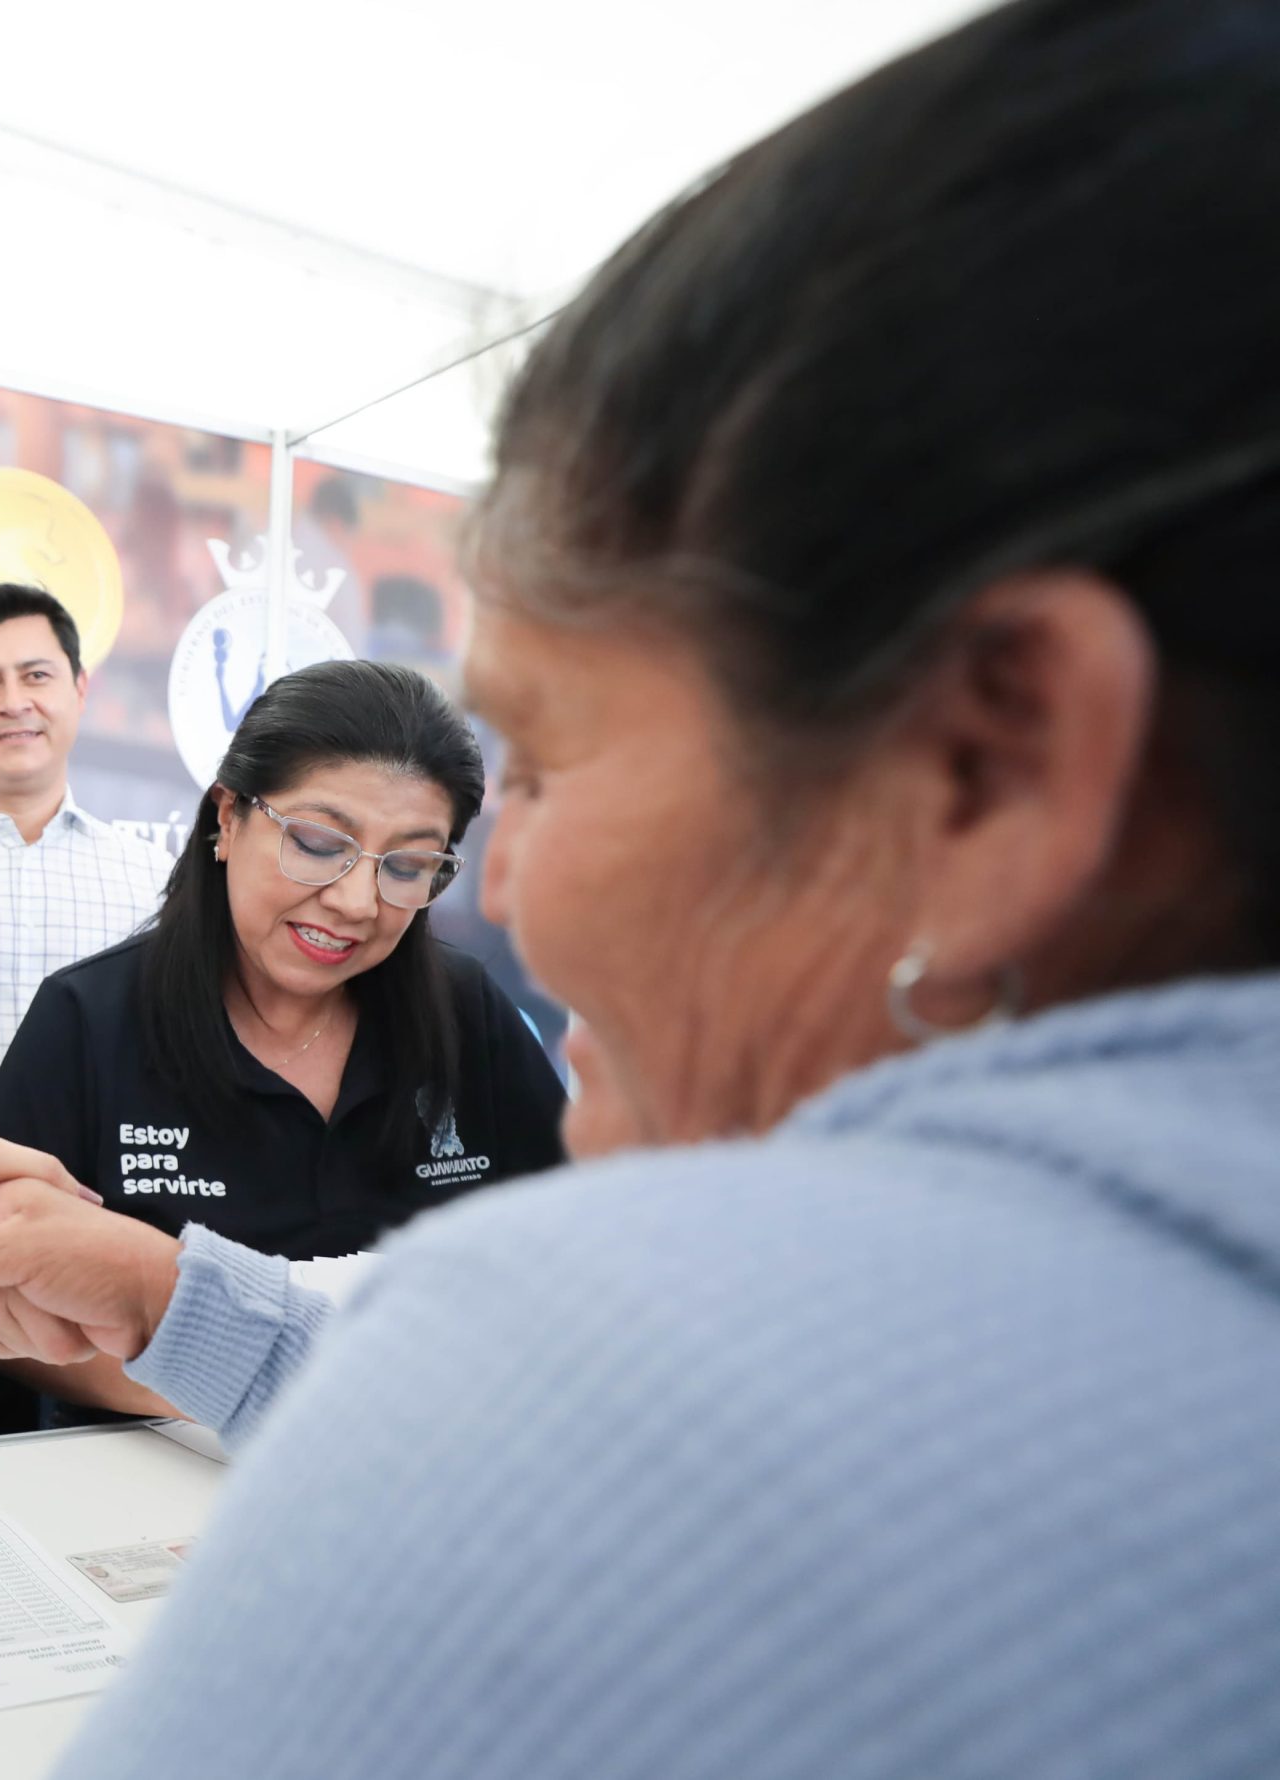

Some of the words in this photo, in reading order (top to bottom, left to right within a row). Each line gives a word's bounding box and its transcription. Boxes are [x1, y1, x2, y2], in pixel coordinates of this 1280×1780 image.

[119, 1123, 189, 1150] Estoy
[120, 1153, 179, 1175] para
[122, 1174, 227, 1197] servirte
